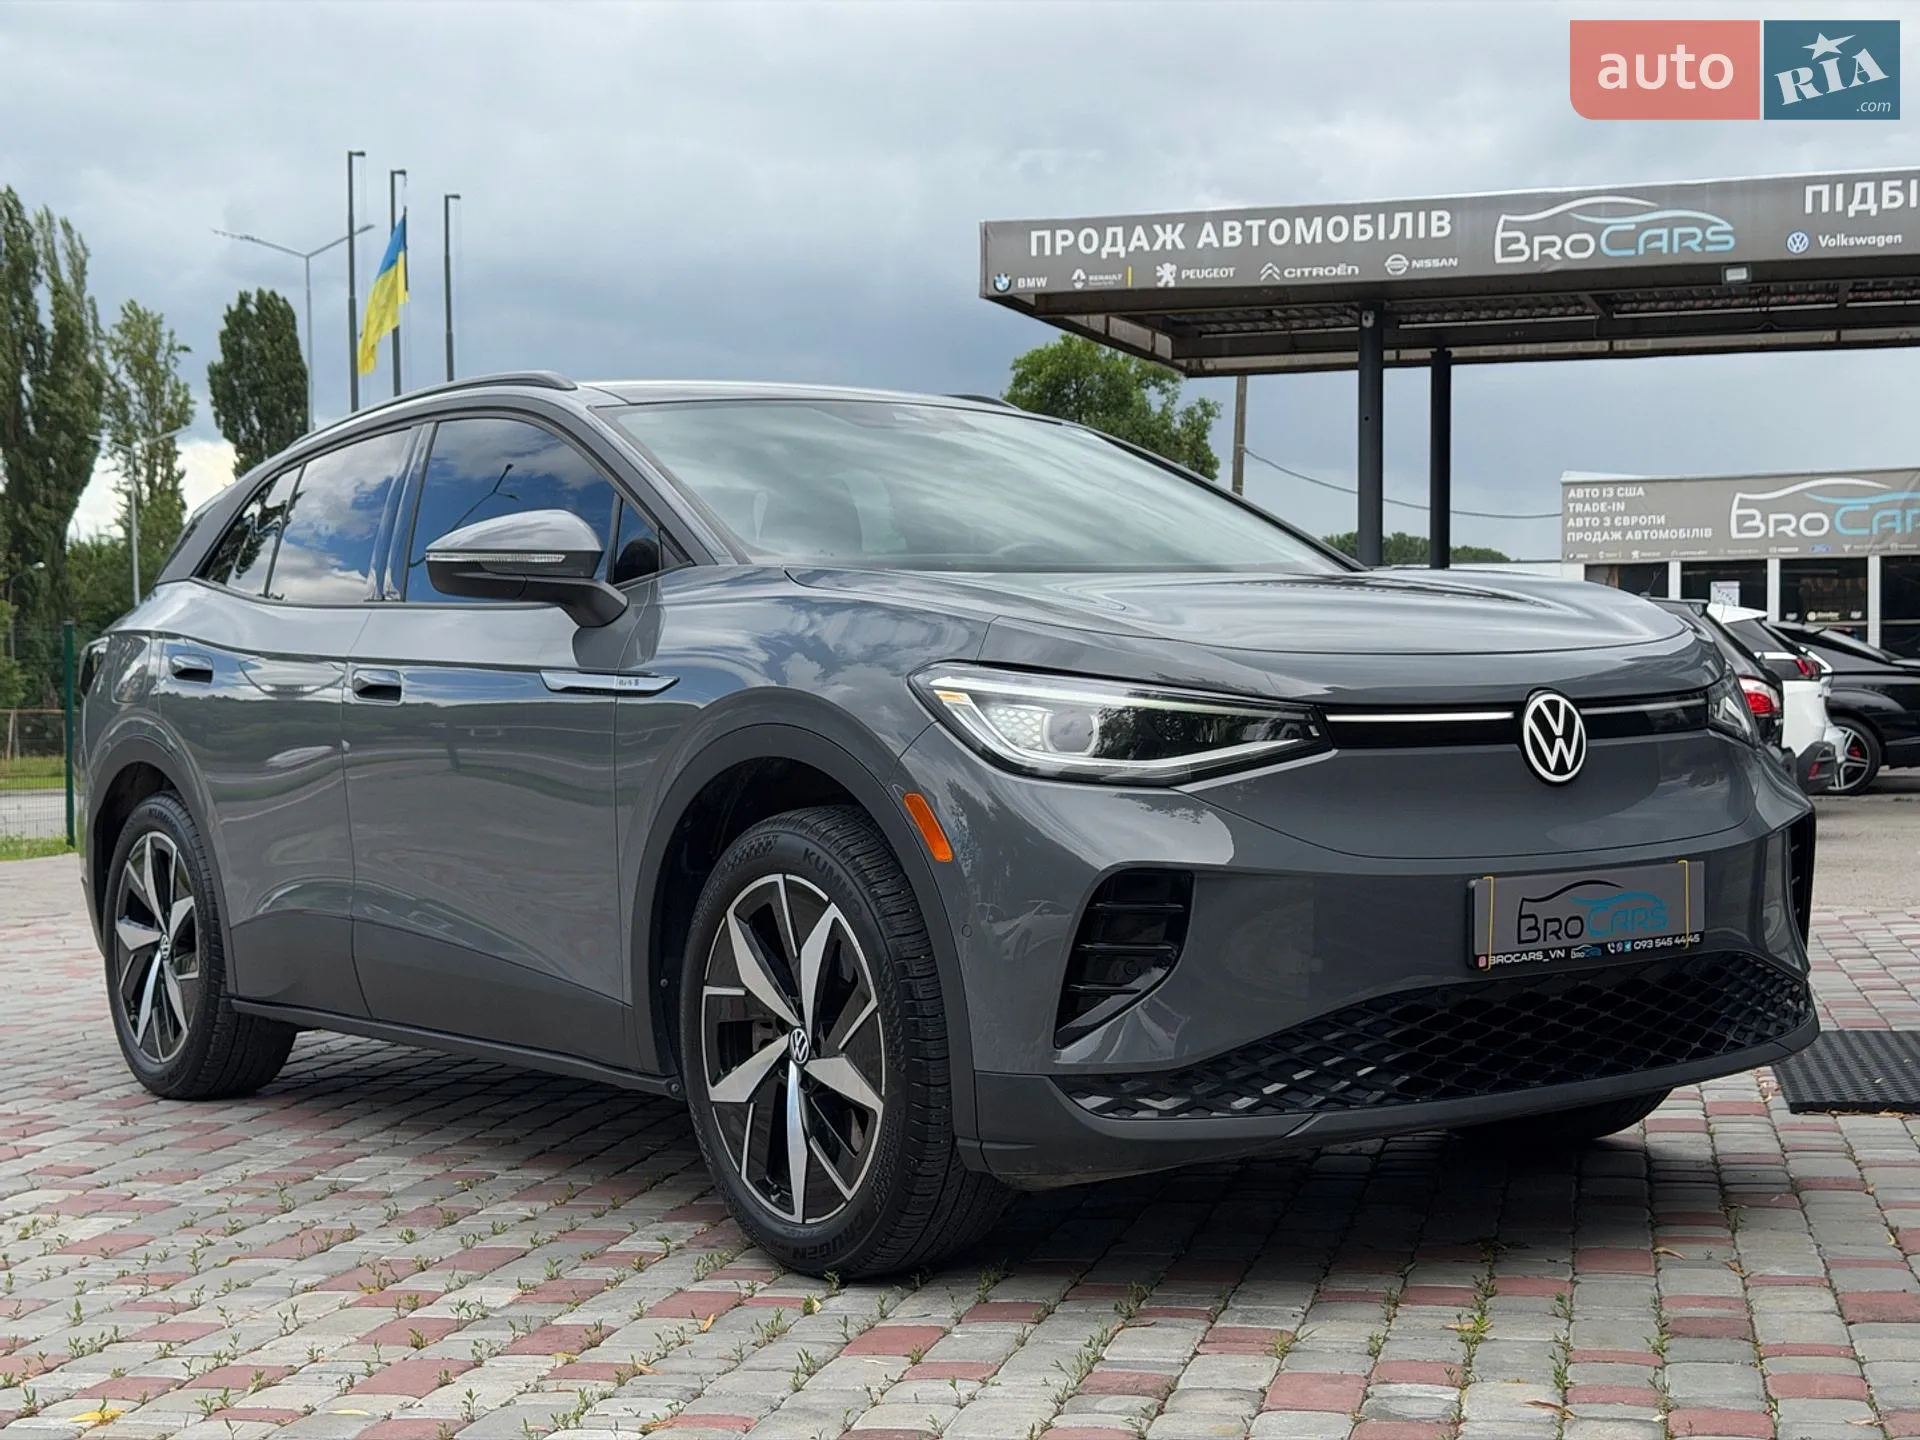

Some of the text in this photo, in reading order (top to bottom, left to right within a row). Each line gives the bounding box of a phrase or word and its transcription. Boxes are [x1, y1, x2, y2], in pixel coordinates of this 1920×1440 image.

[1804, 178, 1918, 218] ПІДБІ
[1030, 209, 1452, 260] ПРОДАЖ АВТОМОБІЛІВ
[1817, 233, 1903, 248] Volkswagen
[1411, 257, 1459, 269] NISSAN
[1181, 267, 1236, 280] PEUGEOT
[1017, 275, 1048, 289] BMW
[1568, 487, 1645, 499] АВТО ІЗ США
[1567, 502, 1625, 513] TRADE-IN
[1567, 517, 1600, 528] АВТО
[1614, 515, 1666, 527] ЄВРОПИ
[1567, 528, 1713, 544] ПРОДАЖ АВТОМОБІЛІВ
[1633, 940, 1654, 950] 093
[1655, 937, 1673, 948] 545
[1489, 949, 1566, 966] BROCARS_VN
